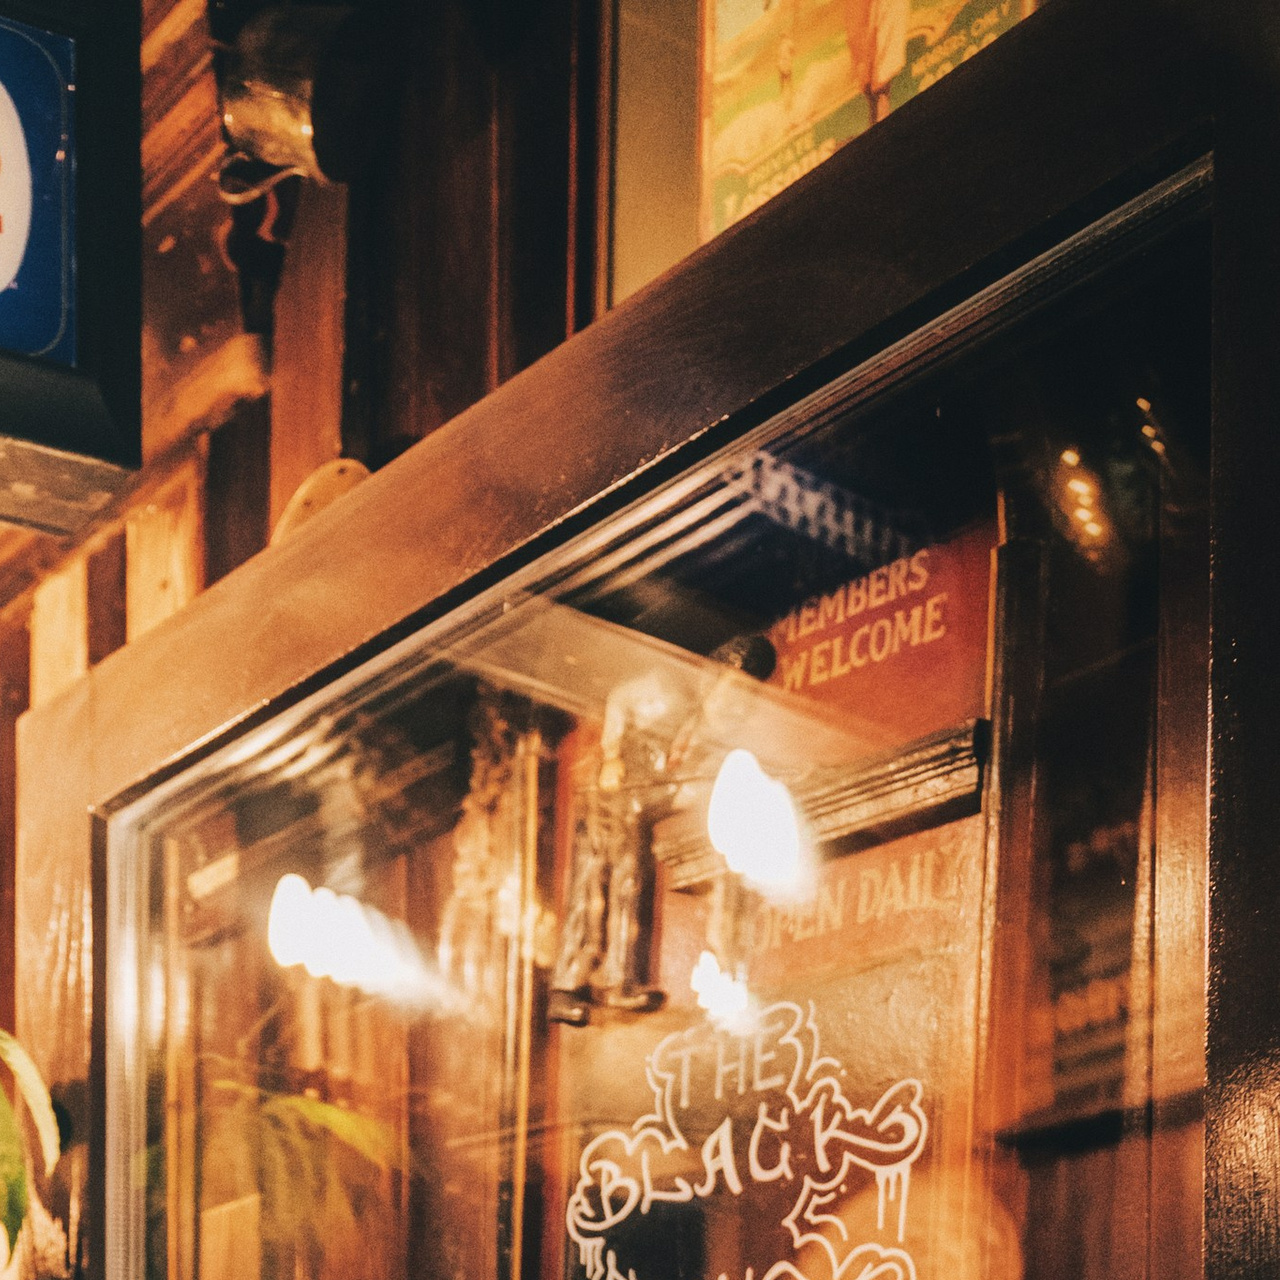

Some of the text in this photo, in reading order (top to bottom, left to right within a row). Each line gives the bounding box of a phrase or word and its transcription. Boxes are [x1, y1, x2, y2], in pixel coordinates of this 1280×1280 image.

[779, 592, 949, 692] WELCOME
[669, 1021, 787, 1109] THE
[572, 1092, 921, 1232] BLACK
